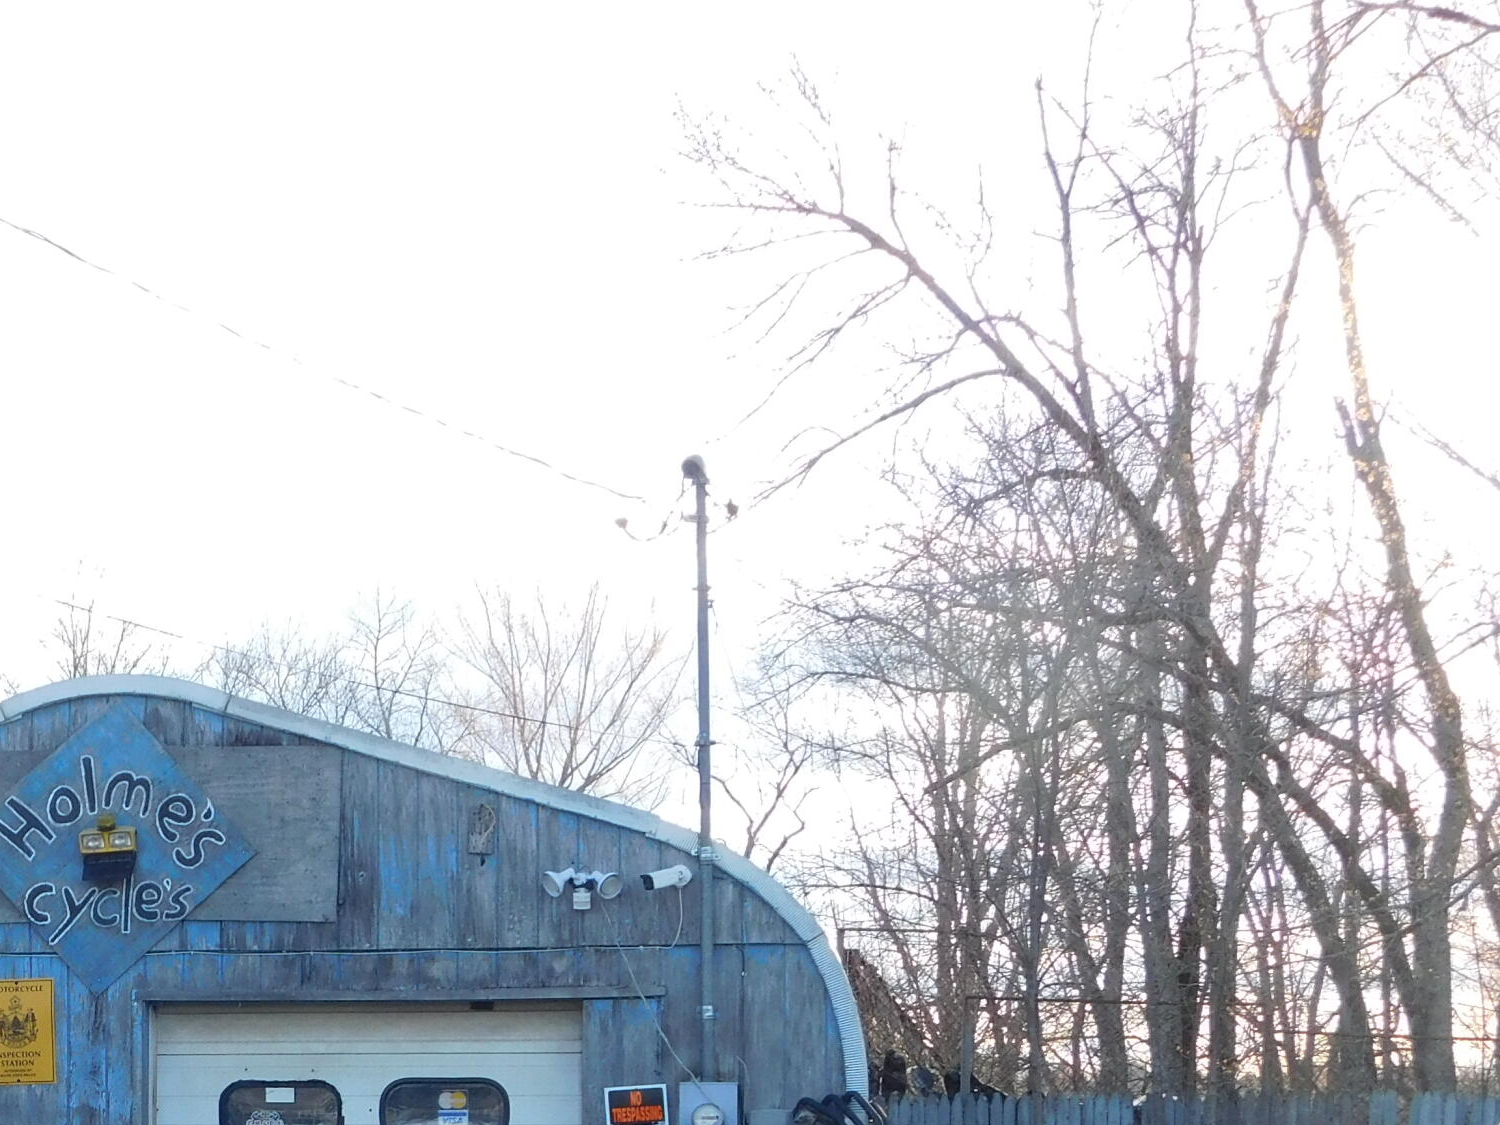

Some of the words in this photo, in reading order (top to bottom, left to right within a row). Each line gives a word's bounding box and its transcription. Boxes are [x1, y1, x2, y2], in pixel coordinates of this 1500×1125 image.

[1, 1059, 35, 1068] STATION
[630, 1090, 643, 1105] NO
[442, 1116, 464, 1124] VISA
[611, 1105, 664, 1123] TRESPASSING
